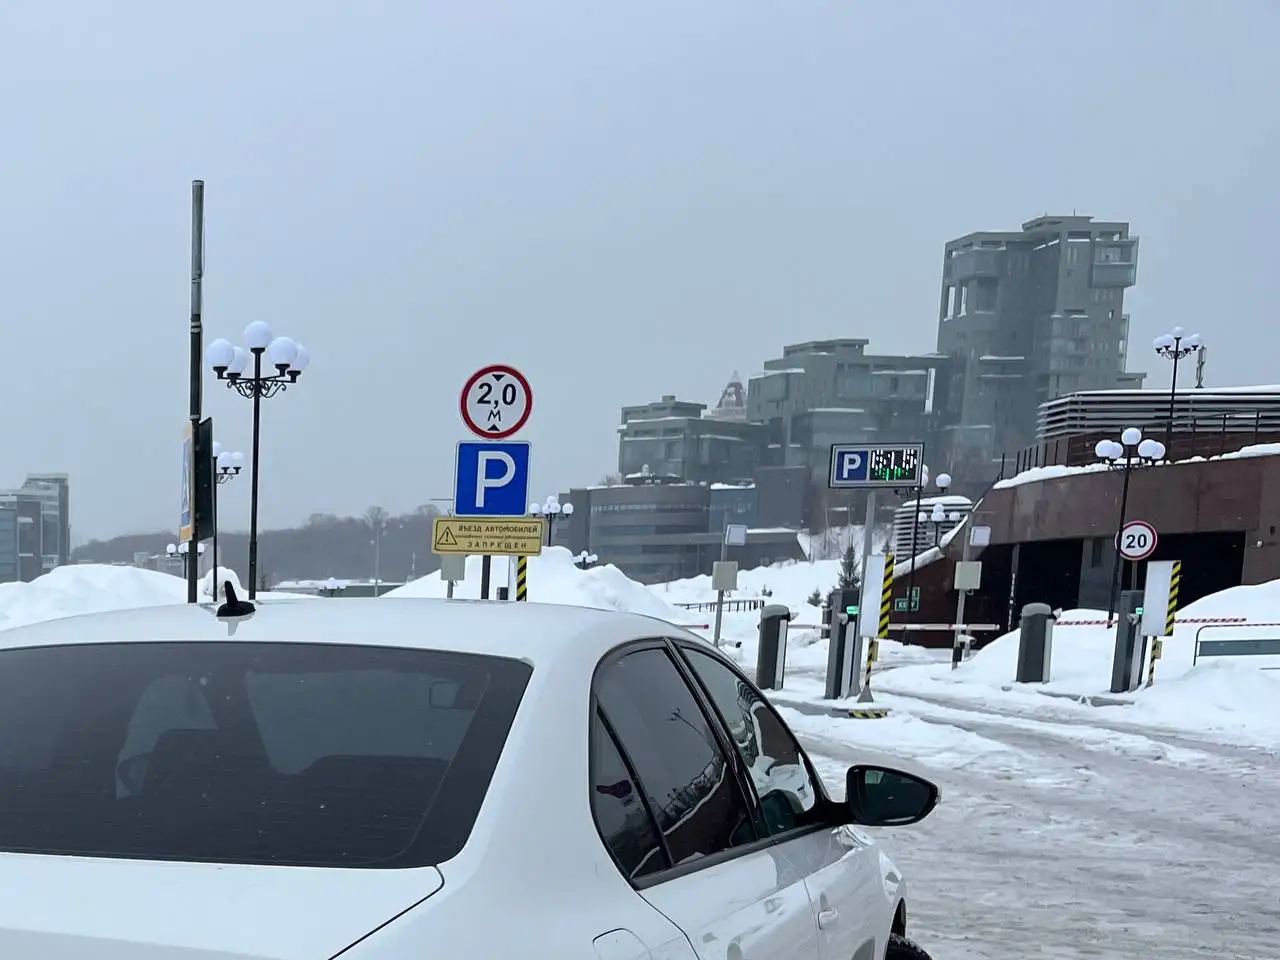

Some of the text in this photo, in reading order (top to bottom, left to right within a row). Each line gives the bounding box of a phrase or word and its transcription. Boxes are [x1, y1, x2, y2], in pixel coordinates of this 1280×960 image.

[477, 383, 516, 409] 2,0
[842, 453, 861, 479] P
[475, 451, 516, 508] P
[458, 525, 538, 534] ВЪЕЗД АВТОМОБИЛЕЙ
[467, 541, 527, 549] ЗАПРЕЩЕН
[1126, 534, 1147, 548] 20
